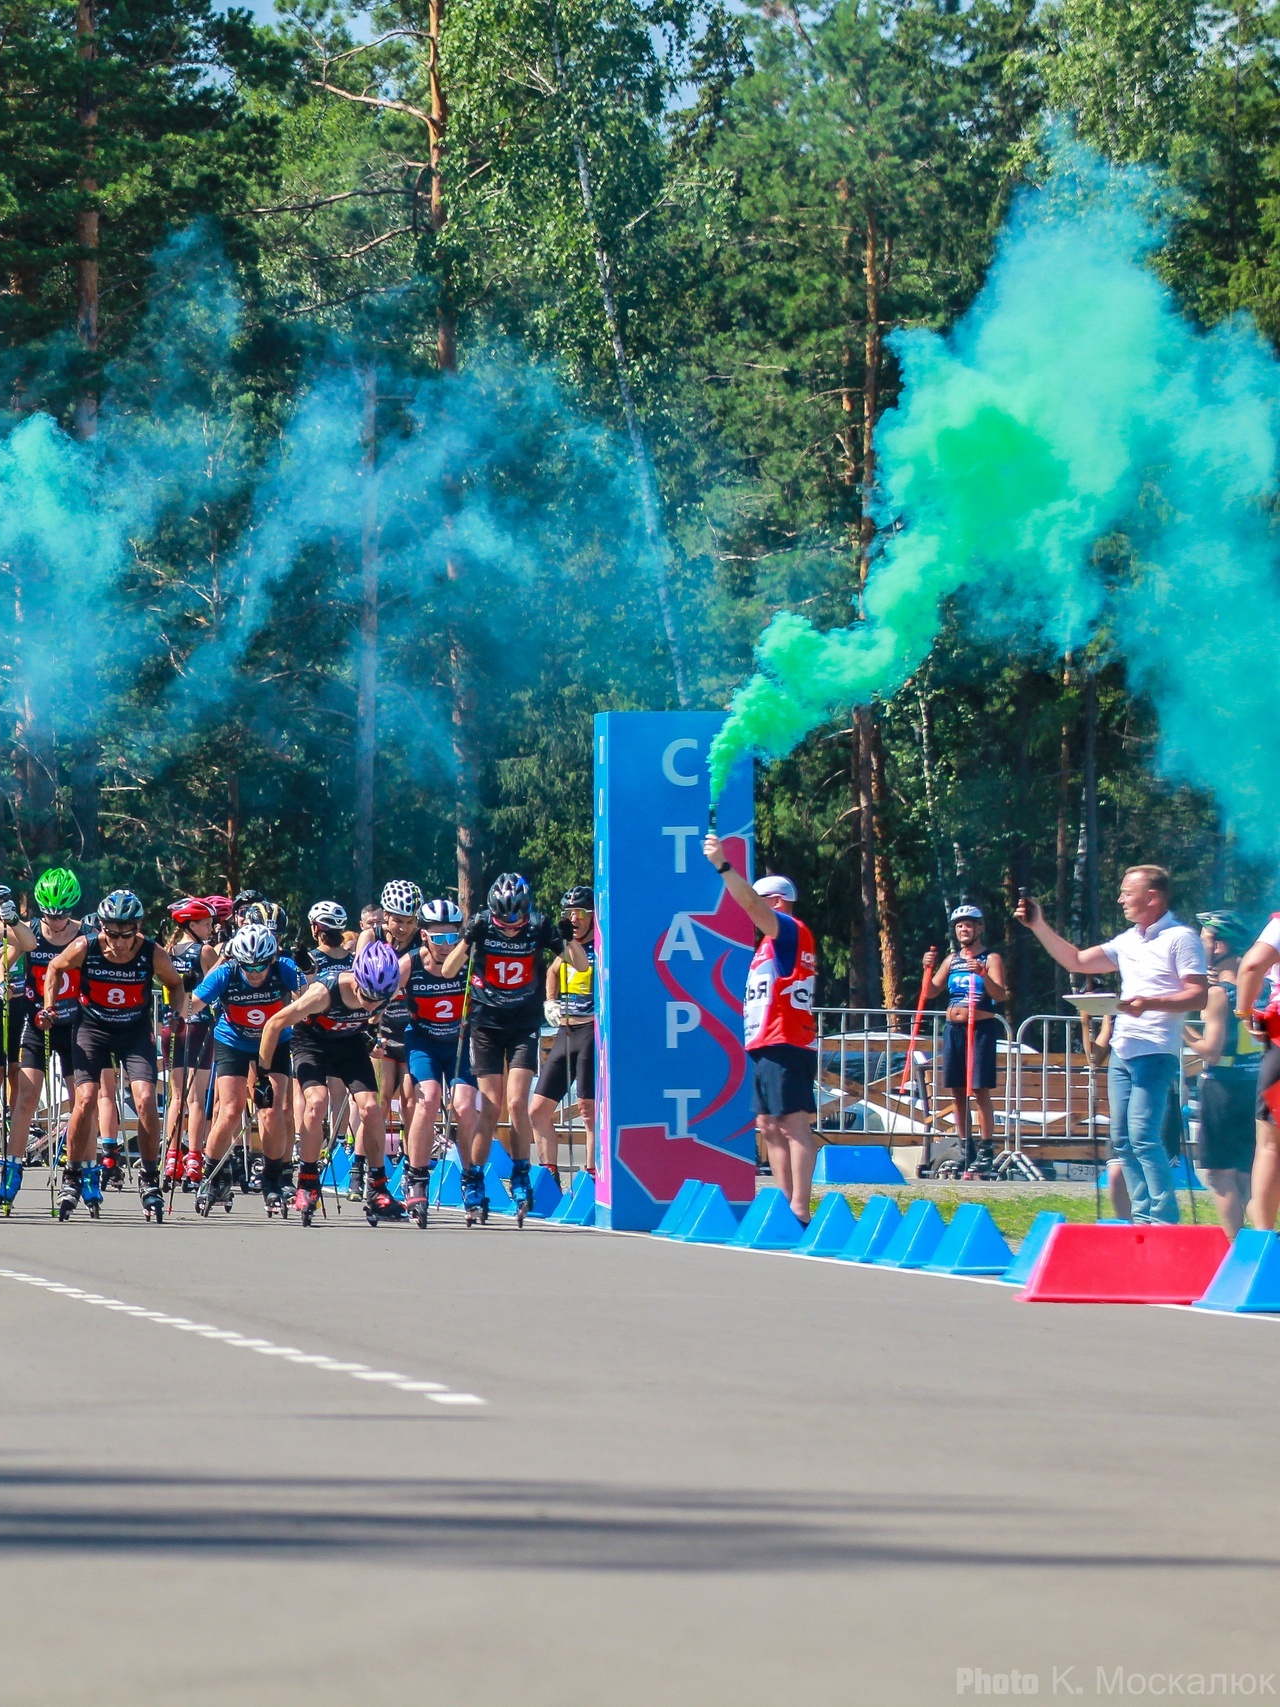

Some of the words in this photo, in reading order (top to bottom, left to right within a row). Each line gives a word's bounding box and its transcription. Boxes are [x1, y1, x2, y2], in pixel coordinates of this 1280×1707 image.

[484, 939, 526, 950] ВОРОБЬИ
[658, 738, 704, 1136] СТАРТ
[30, 951, 61, 960] ВОРО
[88, 968, 136, 978] ВОРОБЬИ
[494, 961, 524, 985] 12
[412, 981, 460, 991] ВОРОБЬИ
[107, 988, 126, 1005] 8
[247, 1009, 265, 1025] 9
[434, 1000, 454, 1018] 2
